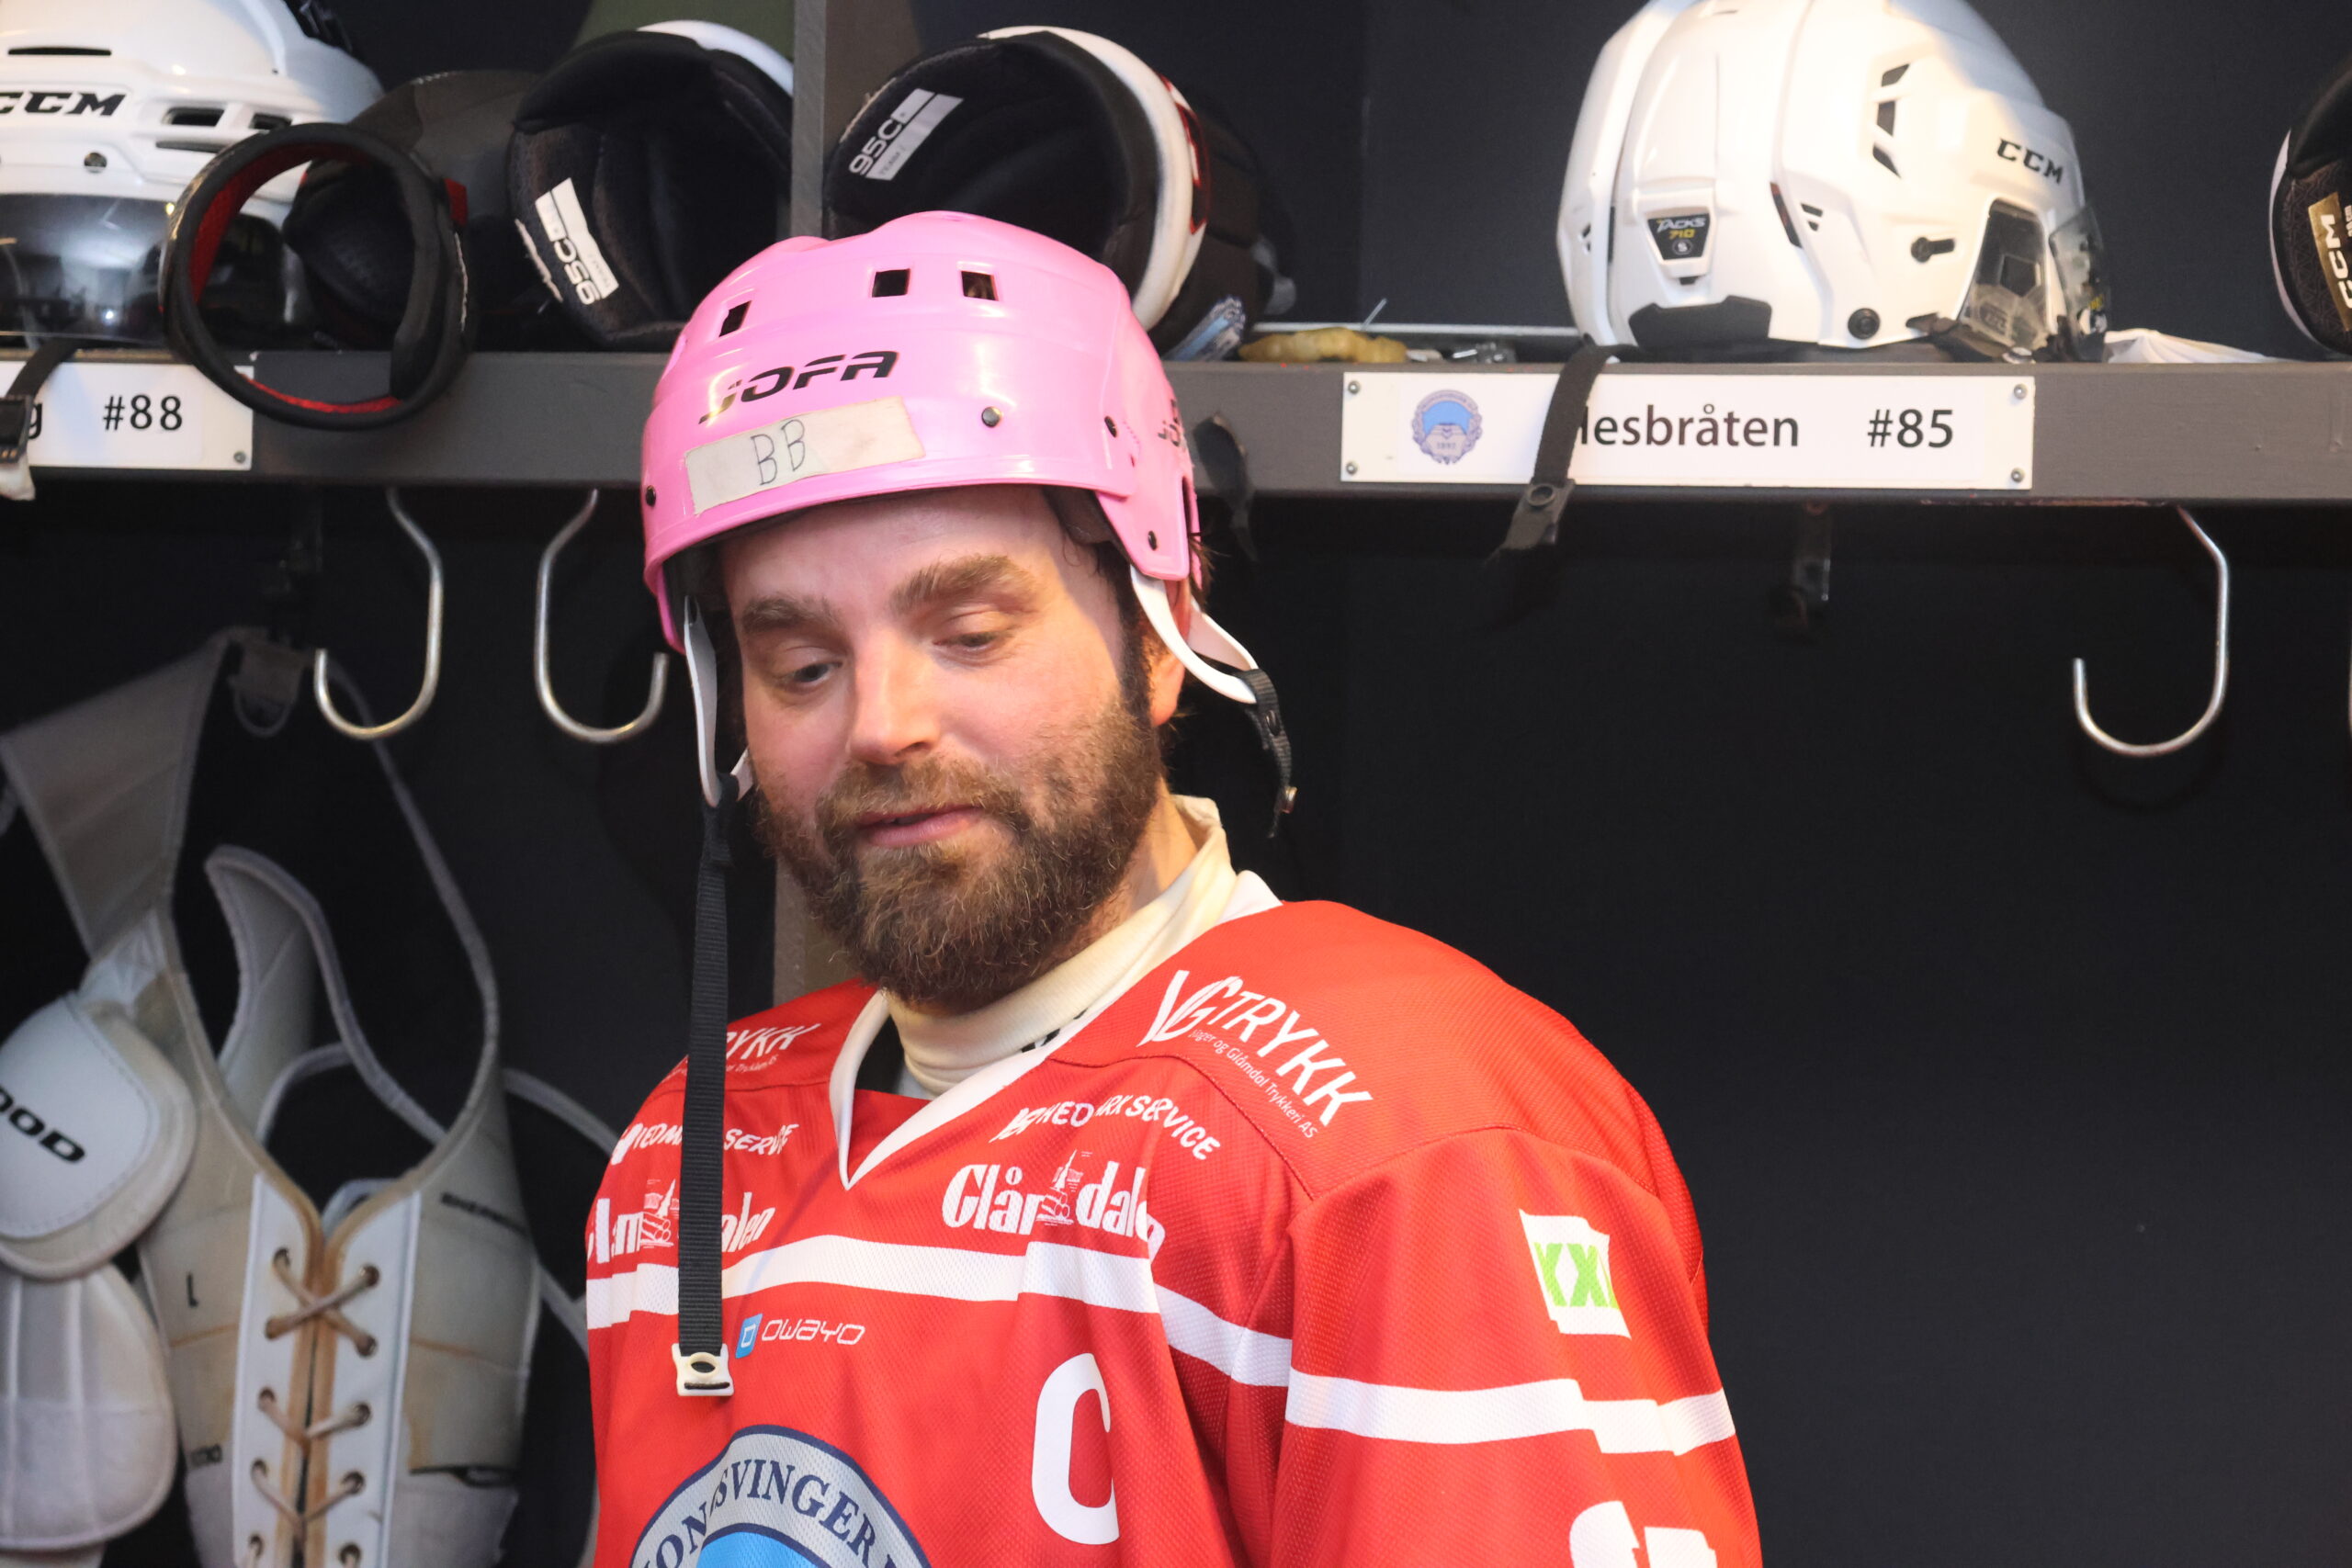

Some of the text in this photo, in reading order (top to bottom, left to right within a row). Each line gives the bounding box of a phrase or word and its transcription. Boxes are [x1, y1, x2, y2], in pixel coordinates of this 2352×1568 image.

[1997, 138, 2064, 186] CCM
[1668, 228, 1696, 240] 710
[698, 350, 899, 425] JOFA
[102, 394, 183, 431] #88
[1867, 409, 1954, 448] #85
[751, 419, 806, 486] BB
[726, 1022, 822, 1060] YKK
[1213, 1040, 1230, 1055] og
[1298, 1122, 1319, 1139] AS
[761, 1318, 865, 1346] owayo
[1031, 1352, 1120, 1546] C
